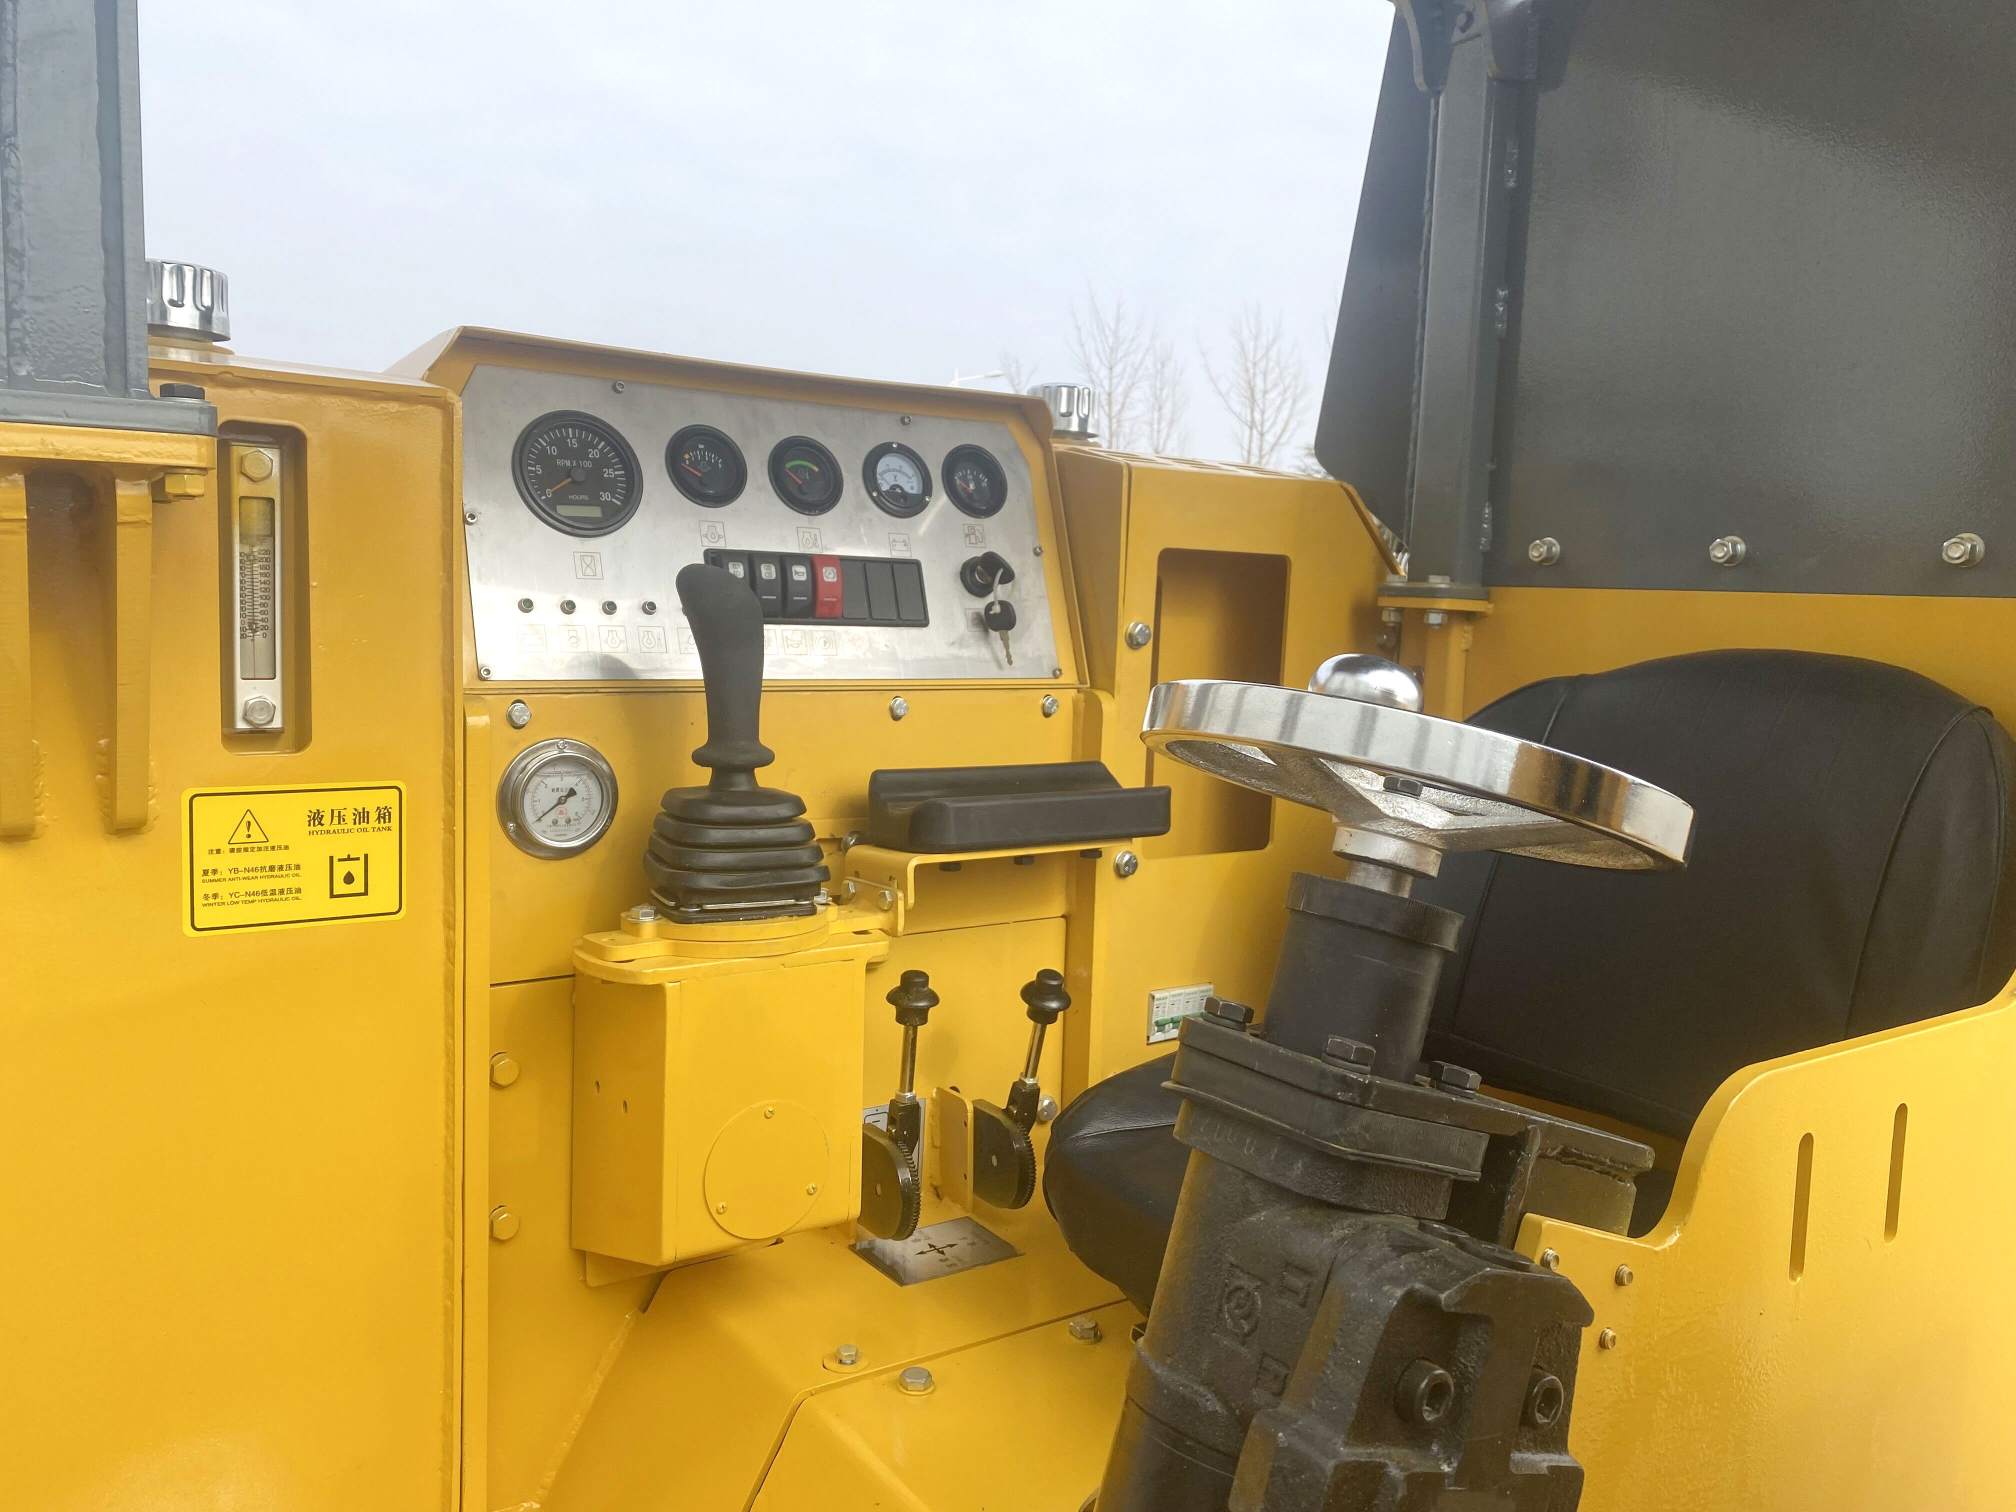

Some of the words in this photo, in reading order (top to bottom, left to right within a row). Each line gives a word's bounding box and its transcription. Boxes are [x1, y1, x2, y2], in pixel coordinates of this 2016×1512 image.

[567, 438, 578, 448] 15
[546, 446, 557, 455] 10
[588, 448, 600, 458] 20
[580, 460, 593, 468] 100
[535, 464, 543, 475] 5
[602, 468, 615, 478] 25
[599, 491, 611, 501] 30
[307, 805, 393, 828] 液压油箱
[308, 827, 355, 837] HYDRAULIC
